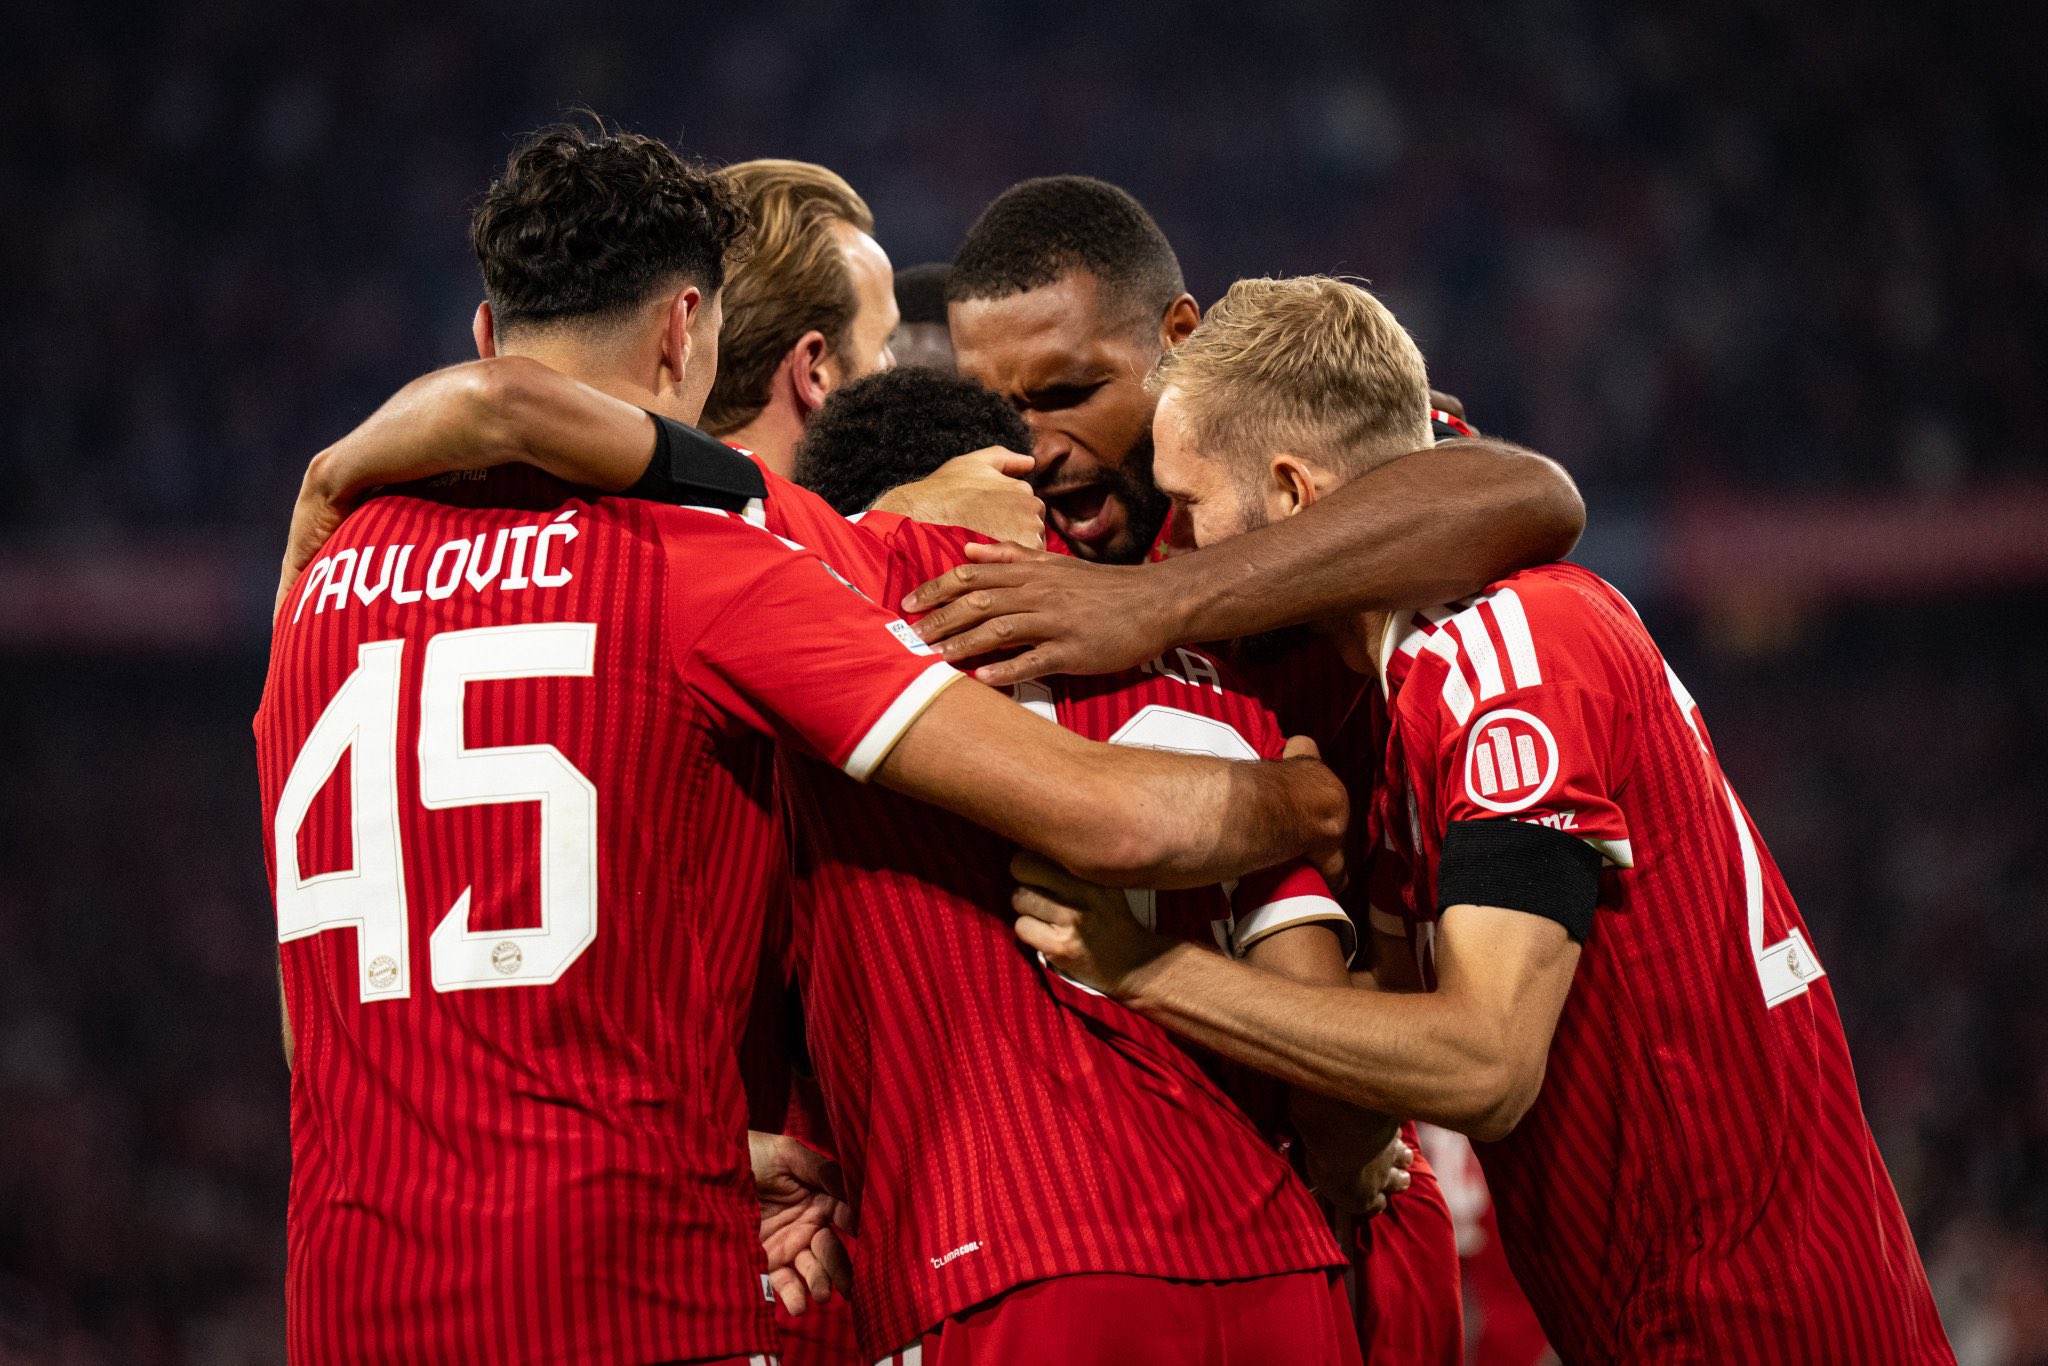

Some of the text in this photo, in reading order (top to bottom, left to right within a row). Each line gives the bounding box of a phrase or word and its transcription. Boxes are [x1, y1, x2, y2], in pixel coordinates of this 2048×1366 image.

[293, 510, 579, 624] PAVLOVIĆ
[275, 622, 598, 1004] 45
[931, 1241, 984, 1269] CLIMACOOL
